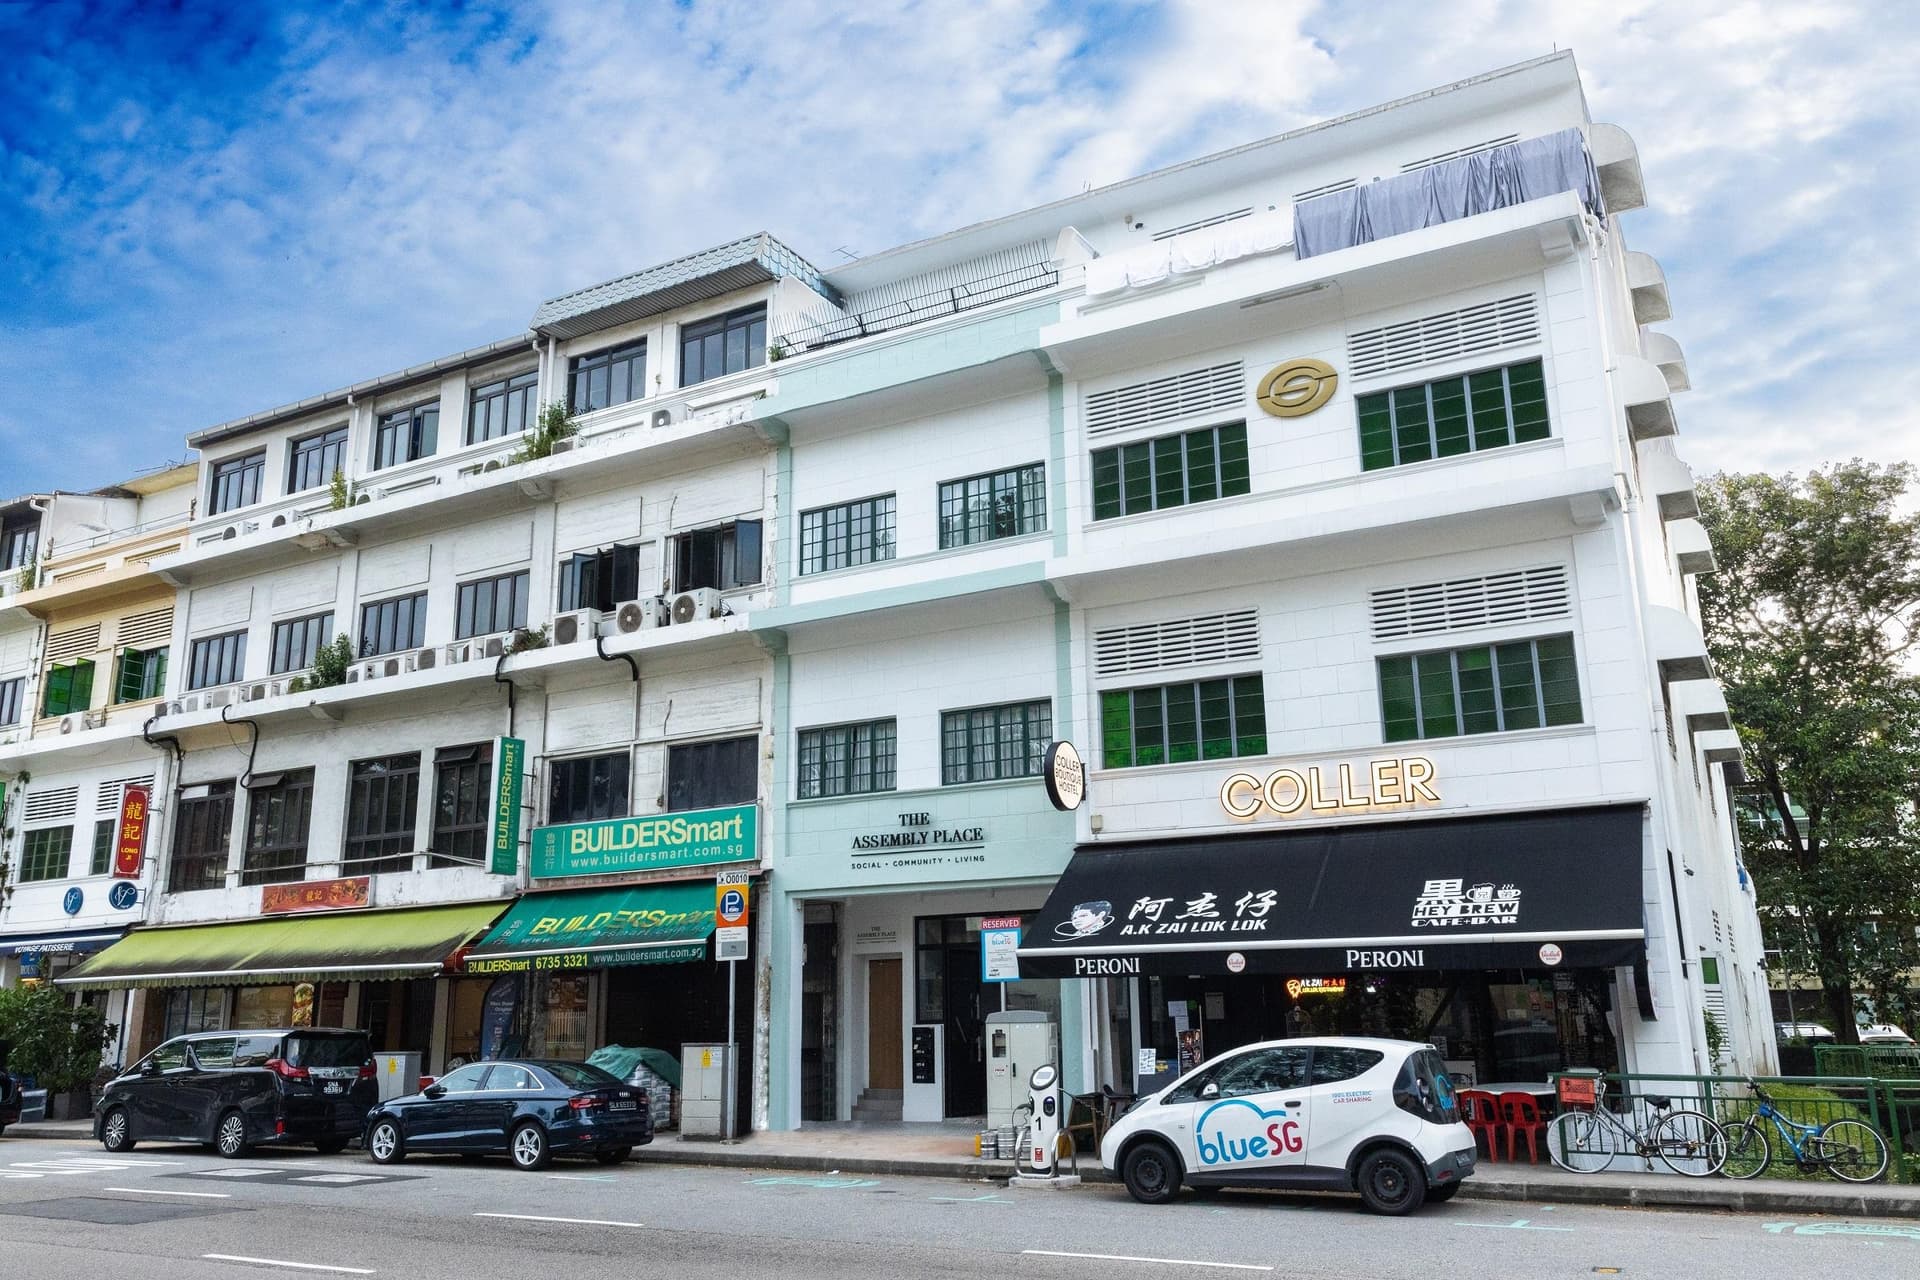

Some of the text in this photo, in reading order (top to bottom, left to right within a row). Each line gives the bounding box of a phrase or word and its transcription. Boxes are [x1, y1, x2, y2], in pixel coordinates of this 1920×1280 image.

[1055, 755, 1080, 772] COLLER
[497, 743, 514, 850] BUILDERSmart
[1059, 779, 1079, 796] HOSTEL
[1220, 757, 1442, 818] COLLER
[123, 802, 143, 840] 龍記
[898, 812, 930, 827] THE
[570, 813, 743, 855] BUILDERSmart
[852, 827, 984, 849] ASSEMBLY PLACE
[570, 843, 743, 868] www.buildersmart.com.sg
[851, 855, 985, 870] SOCIAL COMMUNITY LIVING
[1414, 903, 1517, 916] HEY BREW
[982, 919, 1019, 929] RESERVED
[1120, 918, 1268, 936] A.K ZAI LOK LOK
[468, 947, 703, 973] BUILDERSmart 6735 3321 www.buildersmart.com.sg
[1075, 957, 1140, 975] PERONI
[1346, 949, 1425, 968] PERONI
[1035, 1117, 1042, 1131] 1
[1197, 1121, 1303, 1165] blueSG
